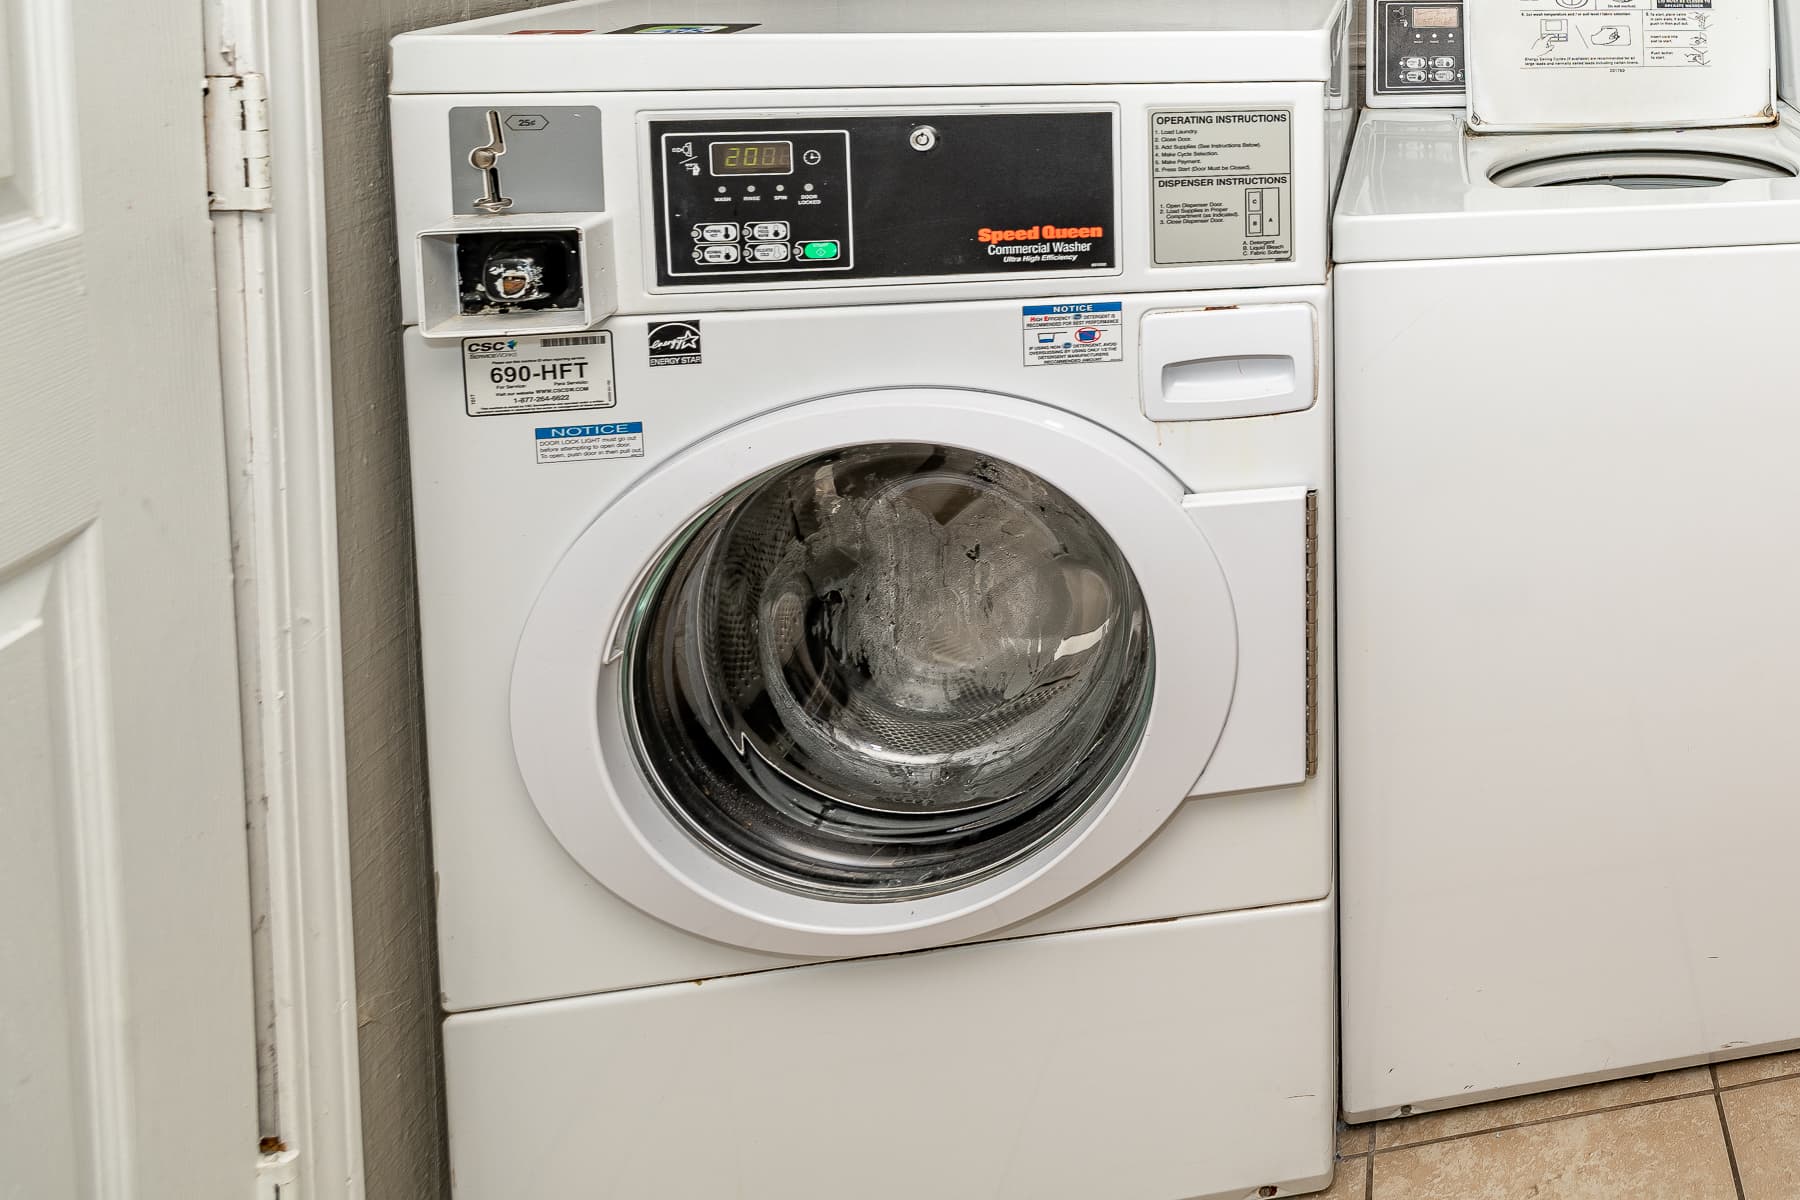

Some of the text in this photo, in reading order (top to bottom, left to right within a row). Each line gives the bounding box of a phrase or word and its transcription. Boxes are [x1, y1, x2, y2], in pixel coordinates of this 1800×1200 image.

[1156, 114, 1287, 125] OPERATING INSTRUCTIONS
[1158, 176, 1288, 188] DISPENSER INSTRUCTIONS
[978, 225, 1103, 245] Speed Queen
[988, 241, 1092, 256] Commercial Washer
[1023, 255, 1041, 263] High
[1041, 254, 1079, 262] Efficiency
[1053, 305, 1094, 313] NOTICE
[468, 341, 506, 353] CSC
[651, 356, 702, 366] ENERGY STAR
[490, 362, 589, 384] 690-HFT
[551, 424, 629, 438] NOTICE
[540, 439, 560, 447] DOOR
[561, 438, 580, 446] LOCK
[560, 445, 592, 453] attempting
[567, 451, 583, 459] push
